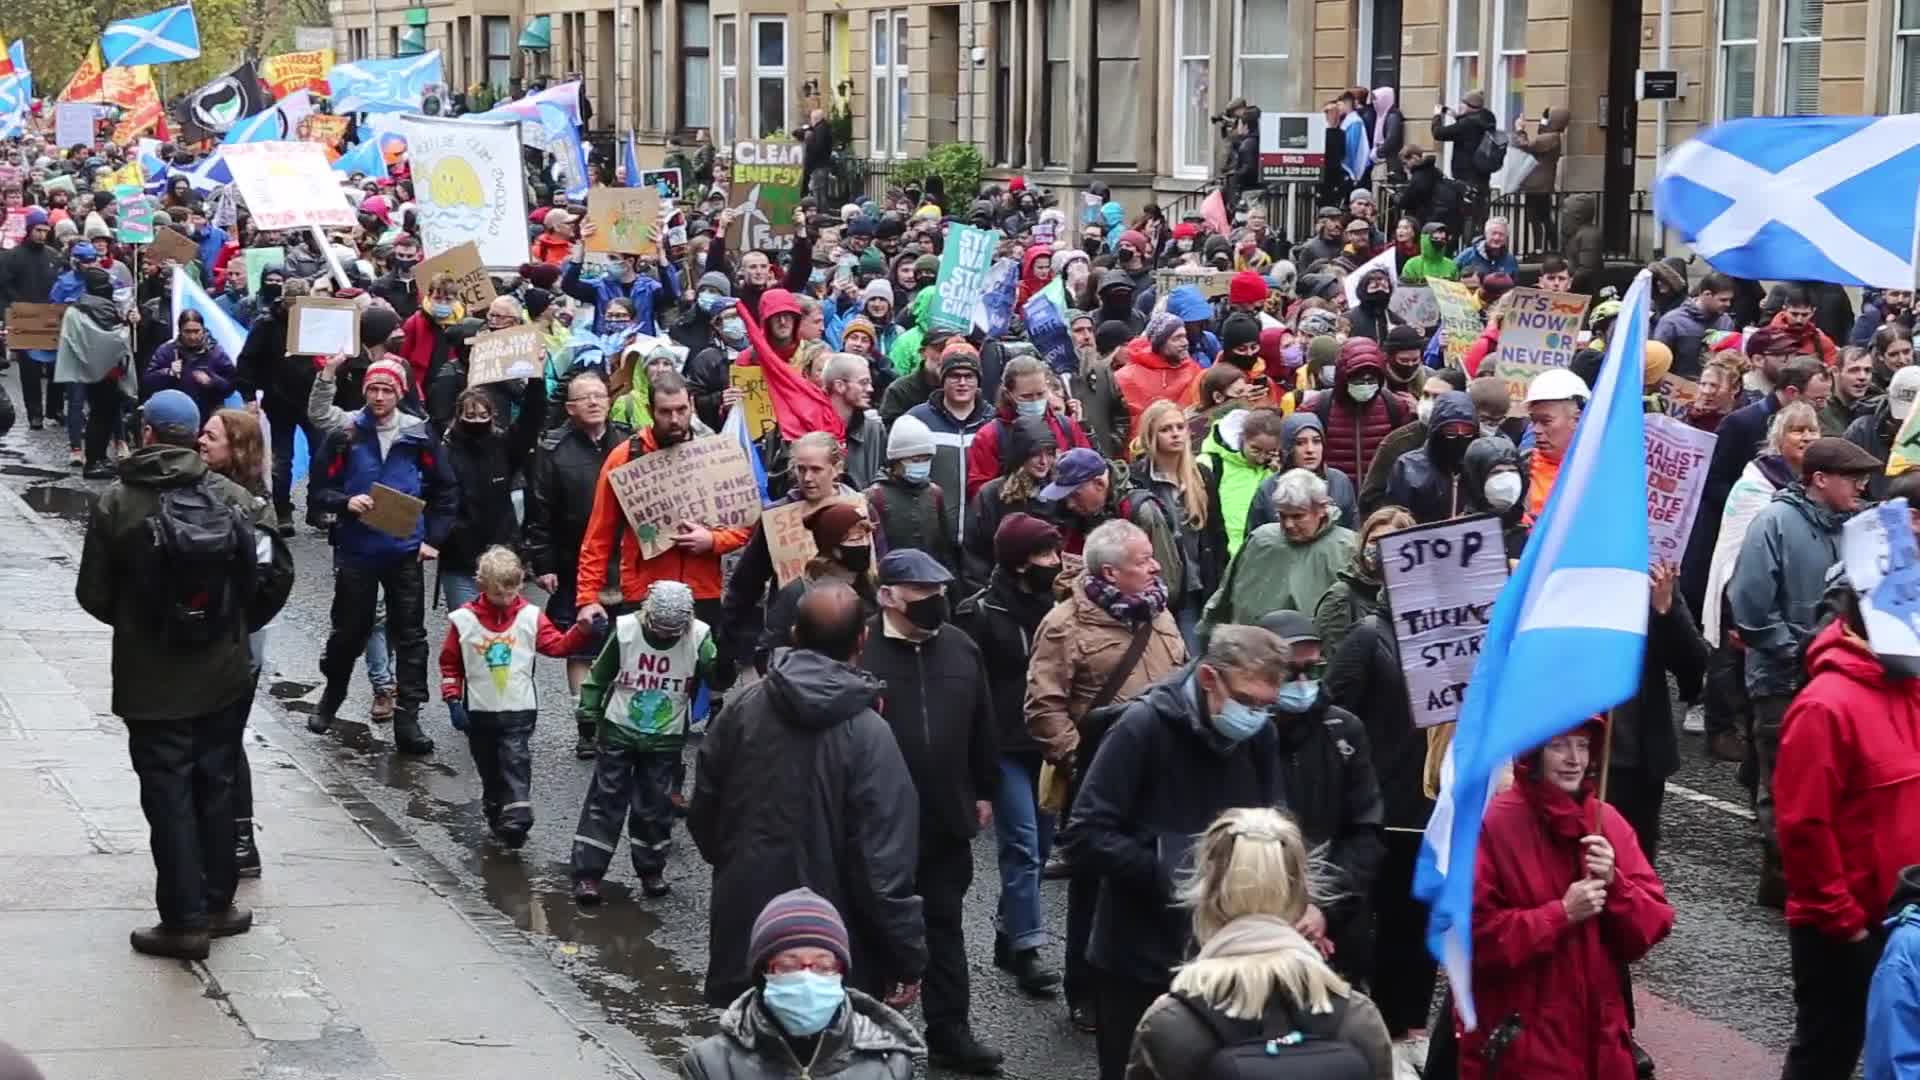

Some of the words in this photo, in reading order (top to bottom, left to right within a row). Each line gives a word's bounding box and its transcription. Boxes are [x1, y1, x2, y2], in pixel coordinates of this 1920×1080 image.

[1512, 293, 1549, 312] IT'S
[1518, 311, 1569, 331] NOW
[616, 455, 673, 487] UNLESS
[634, 491, 692, 522] NOTHING
[713, 473, 753, 493] GOING
[677, 498, 710, 520] GET
[1400, 531, 1484, 573] STOP
[638, 652, 671, 674] NO
